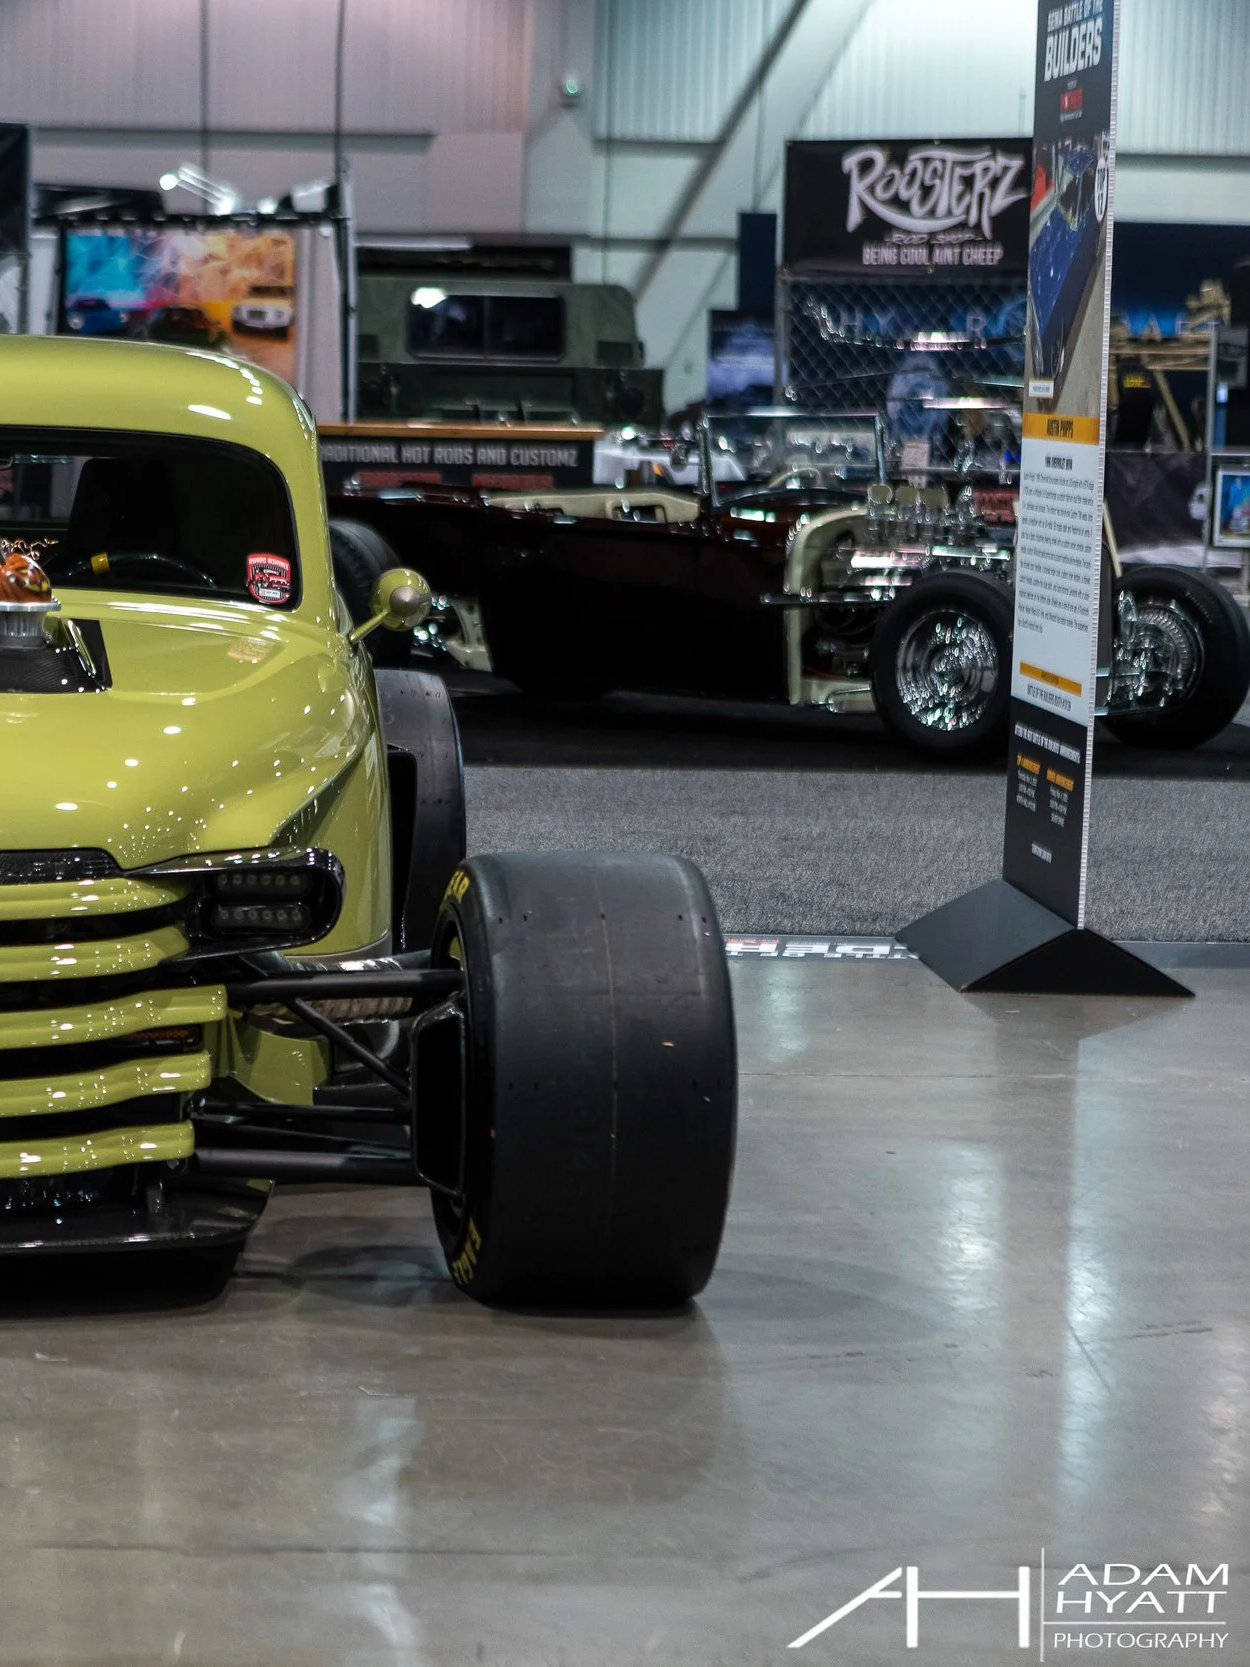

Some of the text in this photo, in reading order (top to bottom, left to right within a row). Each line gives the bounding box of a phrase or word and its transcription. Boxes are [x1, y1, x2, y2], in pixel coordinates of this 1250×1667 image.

[1063, 1, 1083, 27] BATTLE
[1044, 16, 1103, 82] BUILDERS
[842, 148, 1030, 240] ROOSTERZ
[862, 244, 899, 265] BEING
[962, 244, 1004, 265] CHEEP
[321, 442, 578, 467] ADITIONAL HOT RODS AND CUSTOMZ
[249, 557, 289, 569] AWARD NOMINEE
